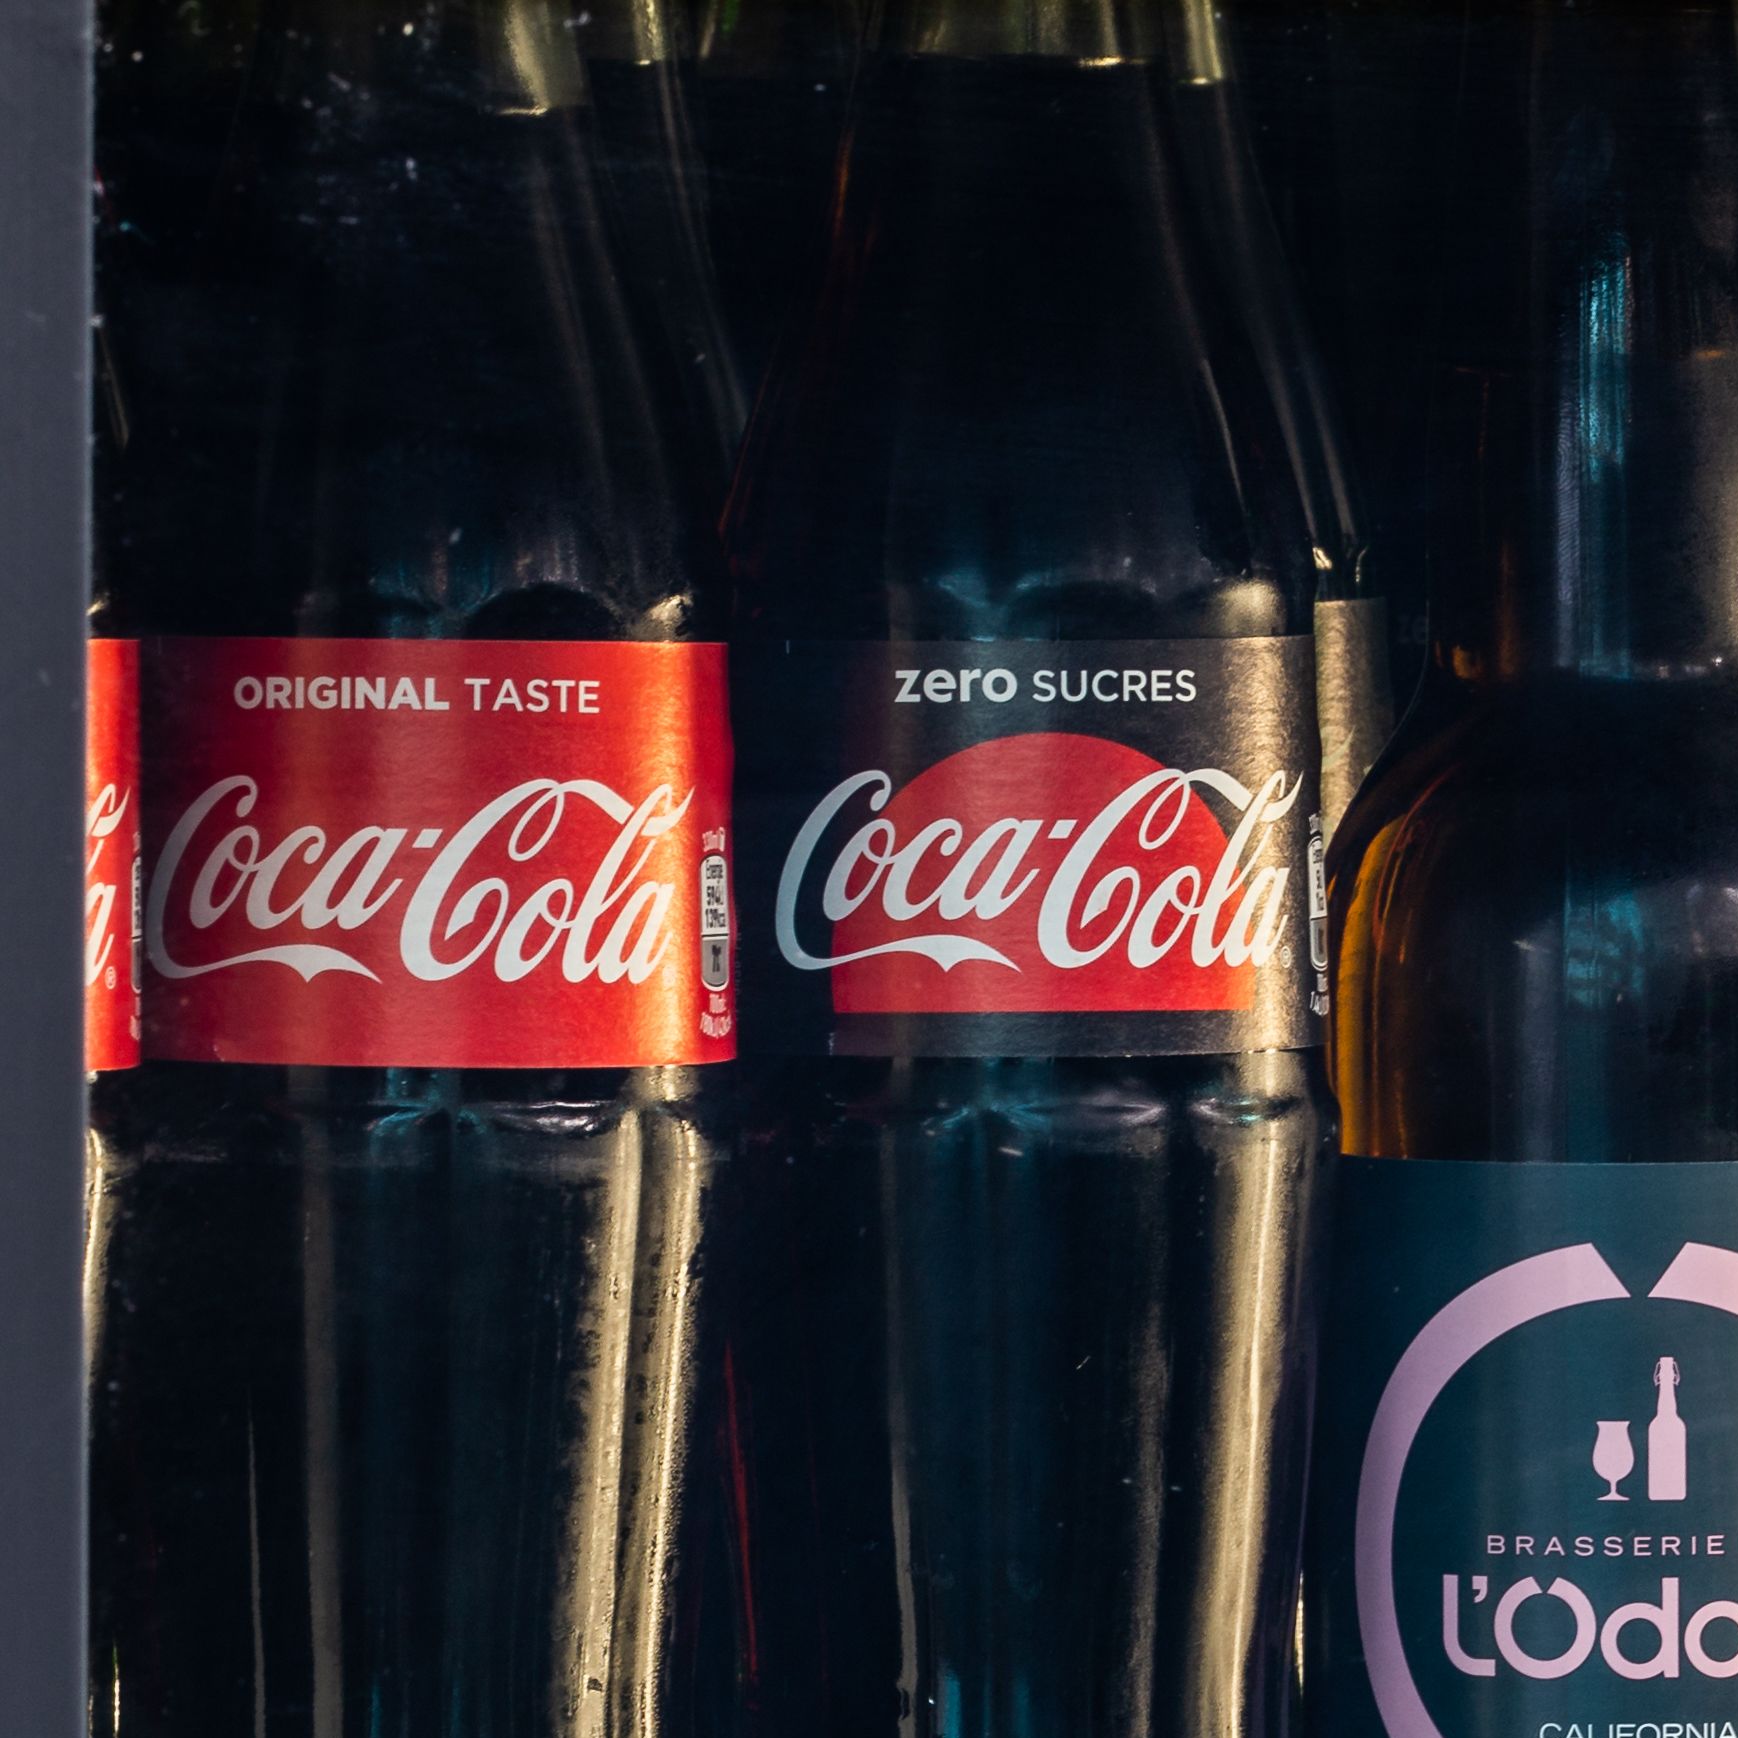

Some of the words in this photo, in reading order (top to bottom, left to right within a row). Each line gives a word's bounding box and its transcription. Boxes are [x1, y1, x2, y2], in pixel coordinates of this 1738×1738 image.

[234, 676, 449, 711] ORIGINAL
[464, 678, 600, 713] TASTE
[895, 668, 1017, 703] zero
[1032, 669, 1197, 703] SUCRES
[146, 775, 694, 984] Coca-Cola
[775, 768, 1303, 973] Coca-Cola
[1486, 1533, 1725, 1557] BRASSERIE
